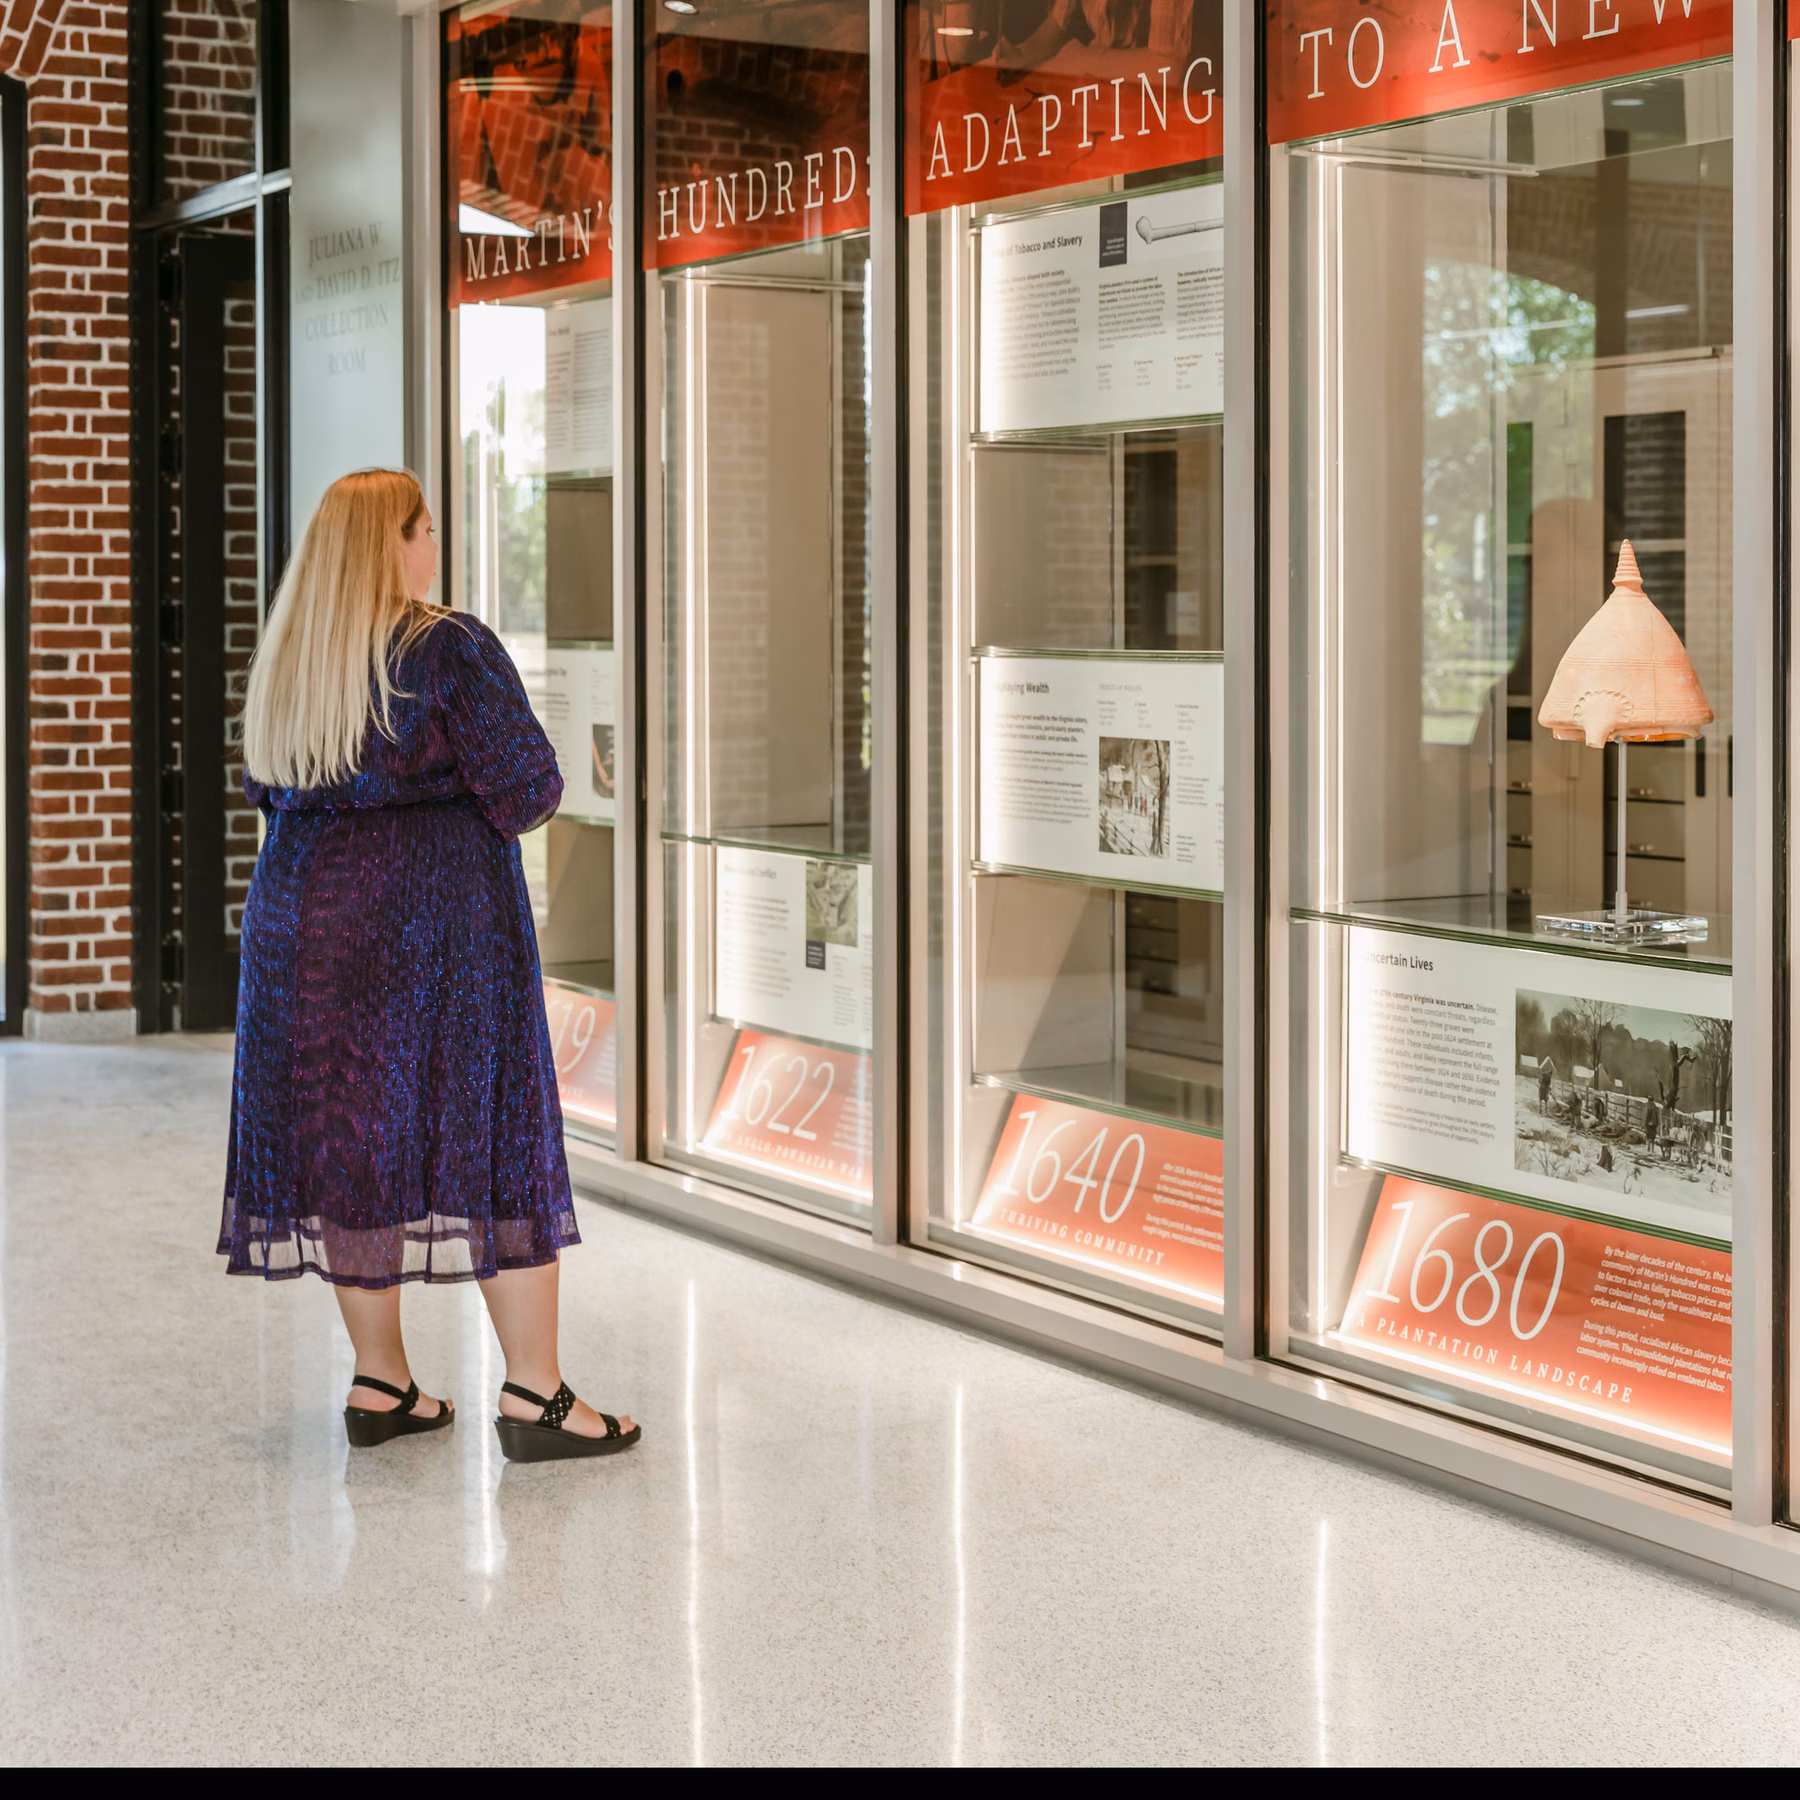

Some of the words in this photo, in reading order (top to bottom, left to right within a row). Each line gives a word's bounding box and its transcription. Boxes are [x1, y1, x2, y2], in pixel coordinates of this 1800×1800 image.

[1299, 17, 1385, 100] TO
[1427, 0, 1471, 74] A
[926, 56, 1216, 182] ADAPTING
[307, 227, 365, 269] JULIANA
[1014, 242, 1041, 256] Tobacco
[1042, 237, 1056, 250] and
[1056, 235, 1083, 248] Slavery
[317, 268, 357, 301] DAVID
[378, 257, 401, 286] ITZ
[304, 303, 389, 342] COLLECTION
[327, 346, 367, 378] ROOM
[1026, 682, 1050, 694] Wealth
[1366, 952, 1408, 968] ncertain
[1410, 956, 1434, 972] Lives
[1414, 995, 1434, 1004] Virginia
[1448, 1002, 1474, 1011] uncertain.
[1477, 1005, 1498, 1016] Disease,
[1424, 1009, 1446, 1018] constant
[1469, 1017, 1495, 1026] regardless
[1458, 1037, 1485, 1048] settlement
[1464, 1061, 1472, 1069] the
[1483, 1066, 1498, 1075] range
[1477, 1075, 1499, 1086] Evidence
[720, 1045, 836, 1141] 1622
[1475, 1088, 1496, 1097] violence
[993, 1110, 1146, 1225] 1640
[999, 1207, 1069, 1239] THRIVING
[1074, 1229, 1166, 1267] COMMUNITY
[1365, 1199, 1567, 1342] 1680
[1601, 1260, 1635, 1276] community
[1636, 1267, 1644, 1276] of
[1644, 1267, 1668, 1282] Martin's
[1669, 1274, 1697, 1289] Hundred
[1698, 1282, 1710, 1292] was
[1605, 1245, 1613, 1258] By
[1614, 1247, 1624, 1258] the
[1625, 1250, 1639, 1261] later
[1640, 1253, 1665, 1268] decades
[1666, 1260, 1673, 1269] of
[1674, 1261, 1685, 1272] the
[1686, 1266, 1711, 1281] century,
[1713, 1270, 1724, 1281] the
[1594, 1285, 1608, 1294] over
[1608, 1288, 1633, 1300] colonial
[1633, 1292, 1651, 1306] trade,
[1652, 1299, 1666, 1311] only
[1667, 1301, 1678, 1312] the
[1679, 1306, 1712, 1320] wealthiest
[1598, 1270, 1605, 1280] to
[1606, 1272, 1626, 1285] factors
[1627, 1279, 1642, 1289] such
[1643, 1283, 1650, 1291] as
[1651, 1283, 1670, 1298] falling
[1671, 1287, 1696, 1302] tobacco
[1697, 1295, 1716, 1307] prices
[1717, 1301, 1730, 1310] and
[1591, 1297, 1609, 1308] cycles
[1610, 1301, 1617, 1310] of
[1617, 1302, 1635, 1314] boom
[1636, 1308, 1648, 1317] and
[1649, 1310, 1665, 1321] bust.
[1580, 1332, 1596, 1344] labor
[1597, 1338, 1619, 1350] system.
[1622, 1343, 1632, 1354] The
[1634, 1348, 1674, 1365] consolidated
[1674, 1357, 1710, 1374] plantations
[1712, 1366, 1726, 1378] that
[1584, 1319, 1604, 1336] During
[1605, 1325, 1616, 1336] this
[1616, 1330, 1638, 1343] period,
[1640, 1336, 1669, 1350] racialized
[1670, 1342, 1692, 1356] African
[1693, 1349, 1717, 1365] slavery
[1376, 1317, 1501, 1365] PLANTATION
[1509, 1353, 1635, 1405] LANDSCAPE
[1577, 1347, 1611, 1364] community
[1611, 1355, 1648, 1374] increasingly
[1648, 1367, 1667, 1377] relied
[1677, 1375, 1706, 1387] enslaved
[1706, 1381, 1725, 1392] labor.
